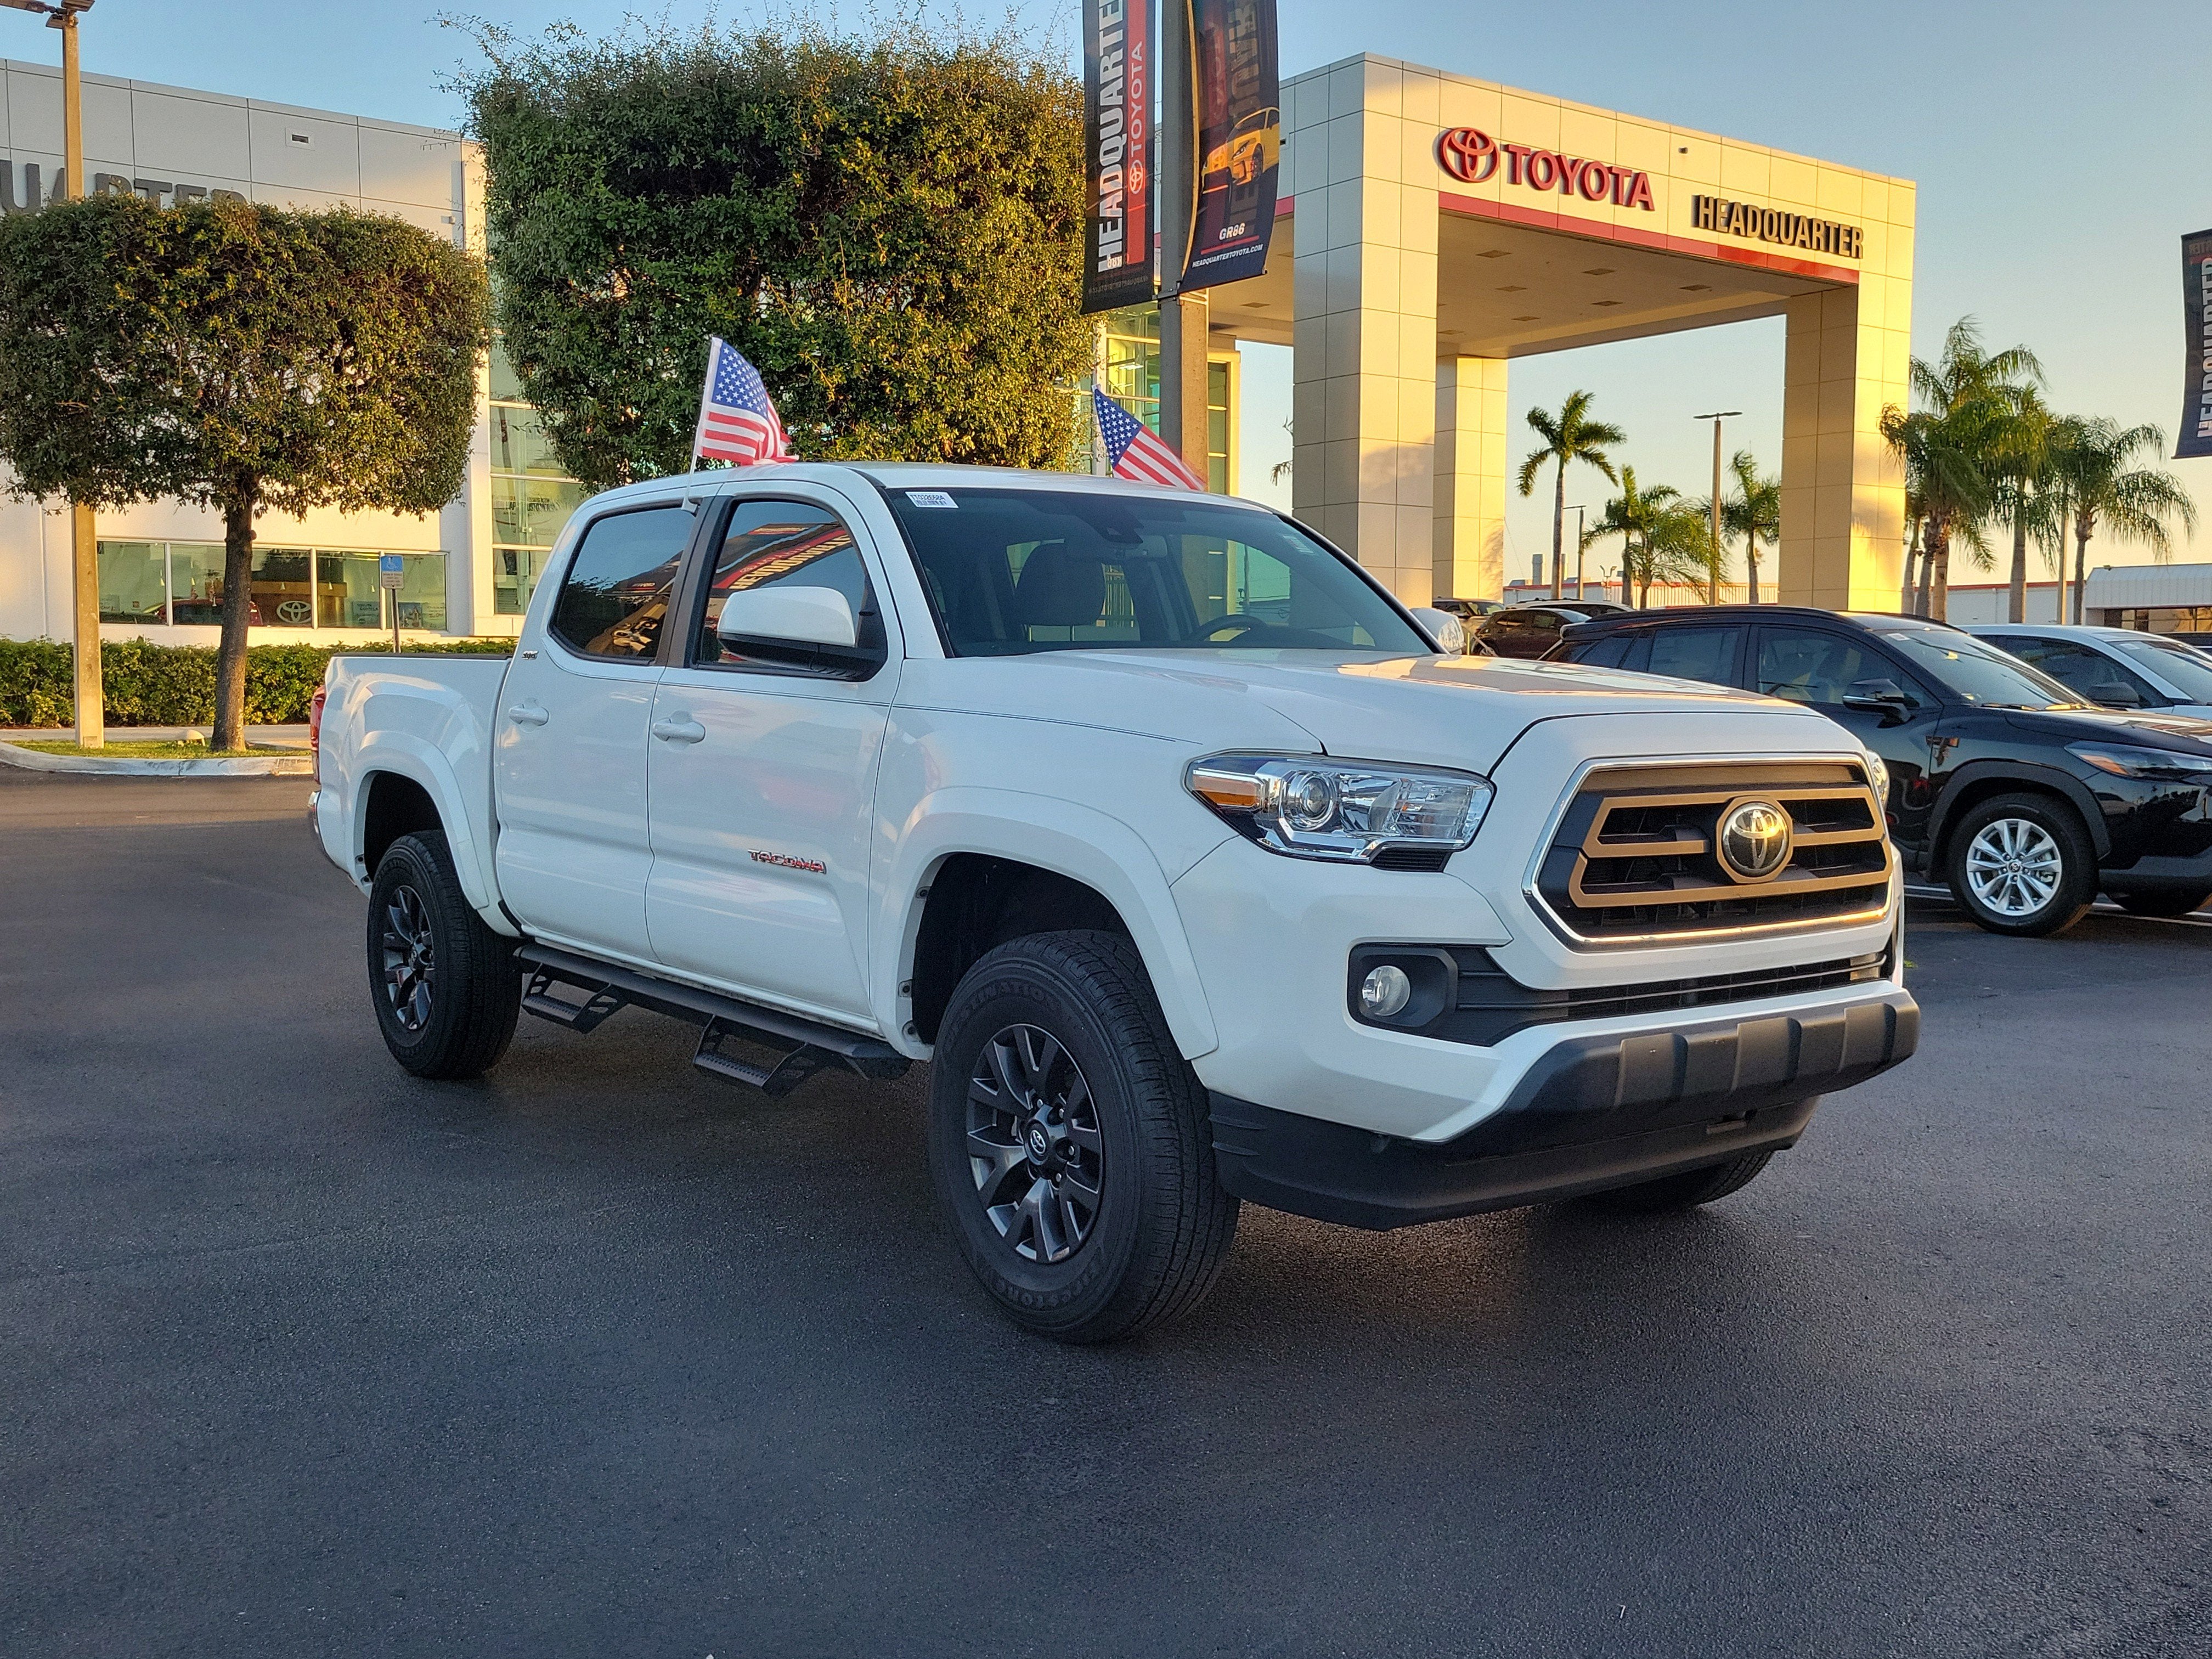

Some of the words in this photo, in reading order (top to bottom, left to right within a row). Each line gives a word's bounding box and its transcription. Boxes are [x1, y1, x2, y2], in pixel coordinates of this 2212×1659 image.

[1131, 41, 1142, 158] TOYOTA
[1098, 0, 1127, 273] HEADQUARTE
[1504, 144, 1655, 212] TOYOTA
[1192, 244, 1263, 268] HEADQUARTERTOYOTA.COM
[1218, 222, 1246, 241] GR86
[1695, 195, 1864, 259] HEADQUARTER
